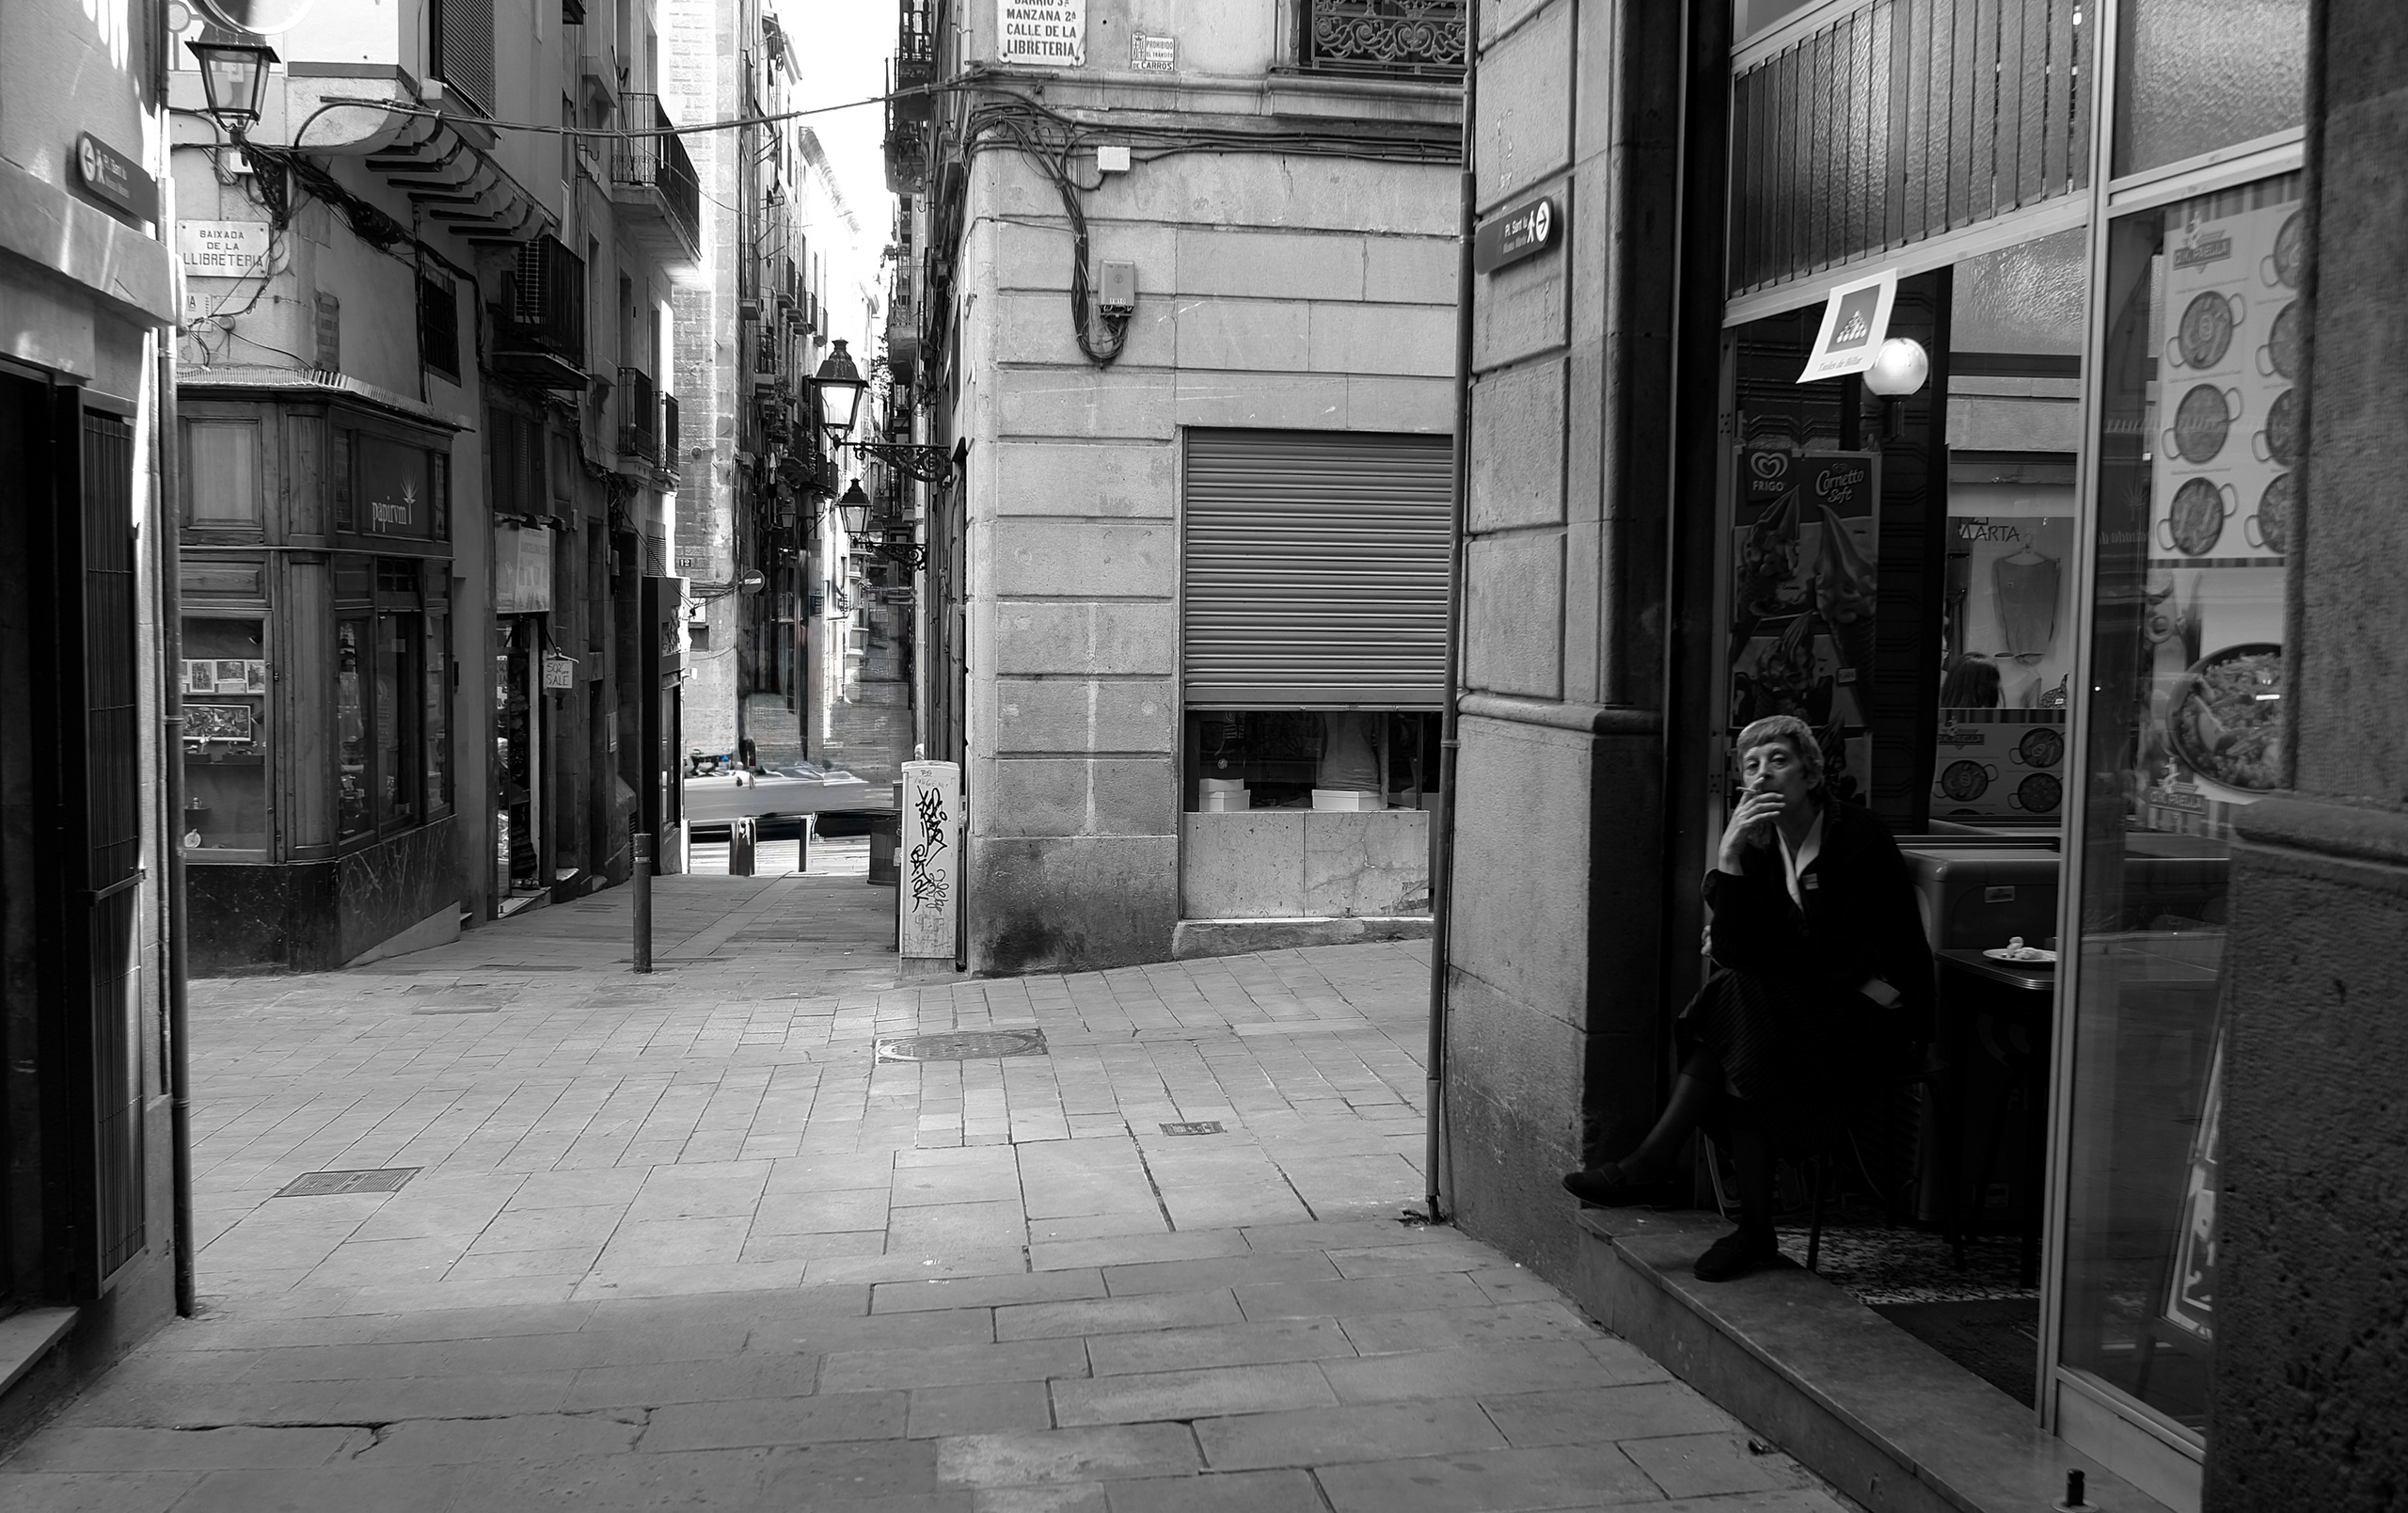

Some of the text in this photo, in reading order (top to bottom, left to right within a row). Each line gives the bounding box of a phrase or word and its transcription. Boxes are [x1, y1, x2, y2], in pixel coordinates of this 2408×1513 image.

[1006, 8, 1061, 22] MANZANA
[1006, 24, 1077, 39] CALLE DE LA
[1006, 40, 1075, 57] LIBRETERIA
[1147, 40, 1174, 50] PROHIBIDO
[1141, 61, 1173, 71] CARROS
[199, 230, 245, 239] BAIXADA
[206, 241, 221, 250] DE
[182, 252, 263, 267] LLIBRETERIA
[1752, 480, 1784, 492] FRIGO
[1814, 469, 1864, 497] Cornetto
[1827, 486, 1853, 504] Soft
[1956, 524, 2020, 543] MARTA
[679, 559, 691, 567] 12
[547, 662, 564, 674] 50%
[546, 673, 569, 686] SALE
